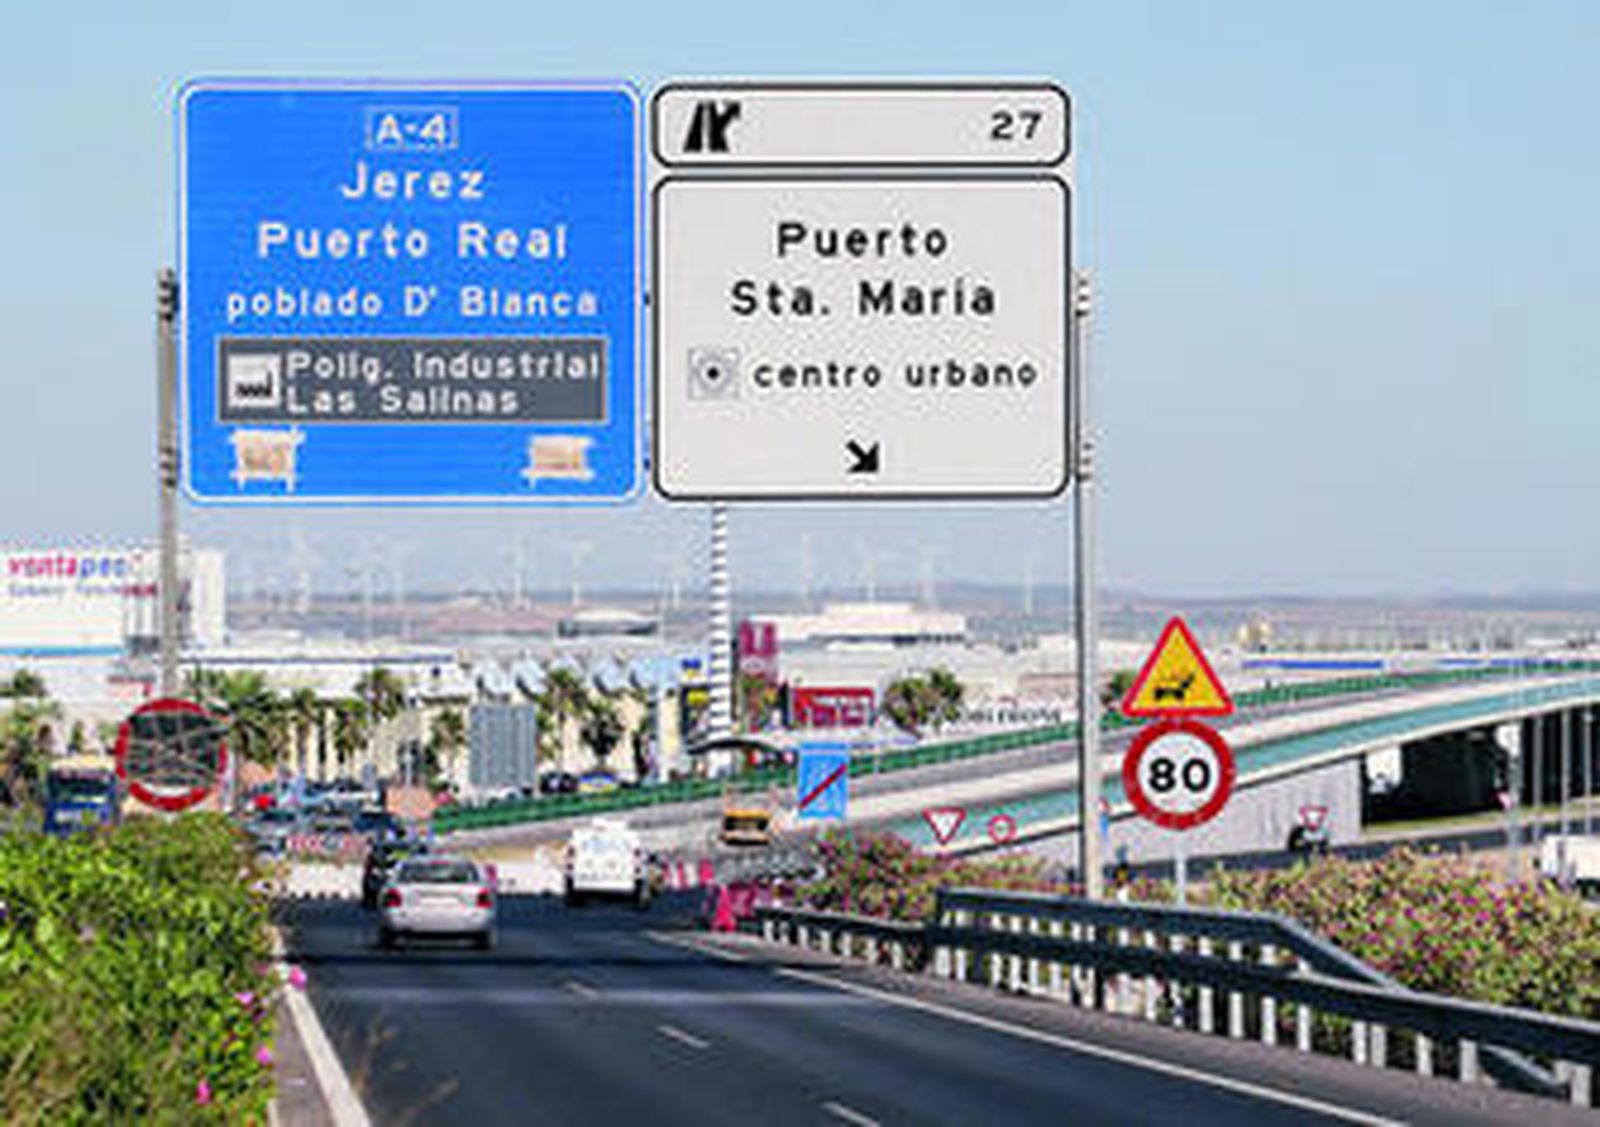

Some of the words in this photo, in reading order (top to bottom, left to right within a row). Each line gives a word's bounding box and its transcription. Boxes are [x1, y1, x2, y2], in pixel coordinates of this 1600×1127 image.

[377, 114, 446, 143] A-4
[991, 111, 1042, 141] 27
[341, 161, 484, 200] Jerez
[258, 221, 428, 258] Puerto
[458, 221, 566, 259] Real
[777, 221, 948, 258] Puerto
[227, 286, 382, 322] poblado
[460, 285, 598, 317] Blanca
[731, 279, 830, 316] Sta.
[414, 351, 599, 379] Industrial
[753, 362, 881, 388] centro
[905, 359, 1038, 388] urbano
[287, 385, 357, 414] Las
[380, 384, 518, 414] Salinas
[1149, 757, 1211, 793] 80
